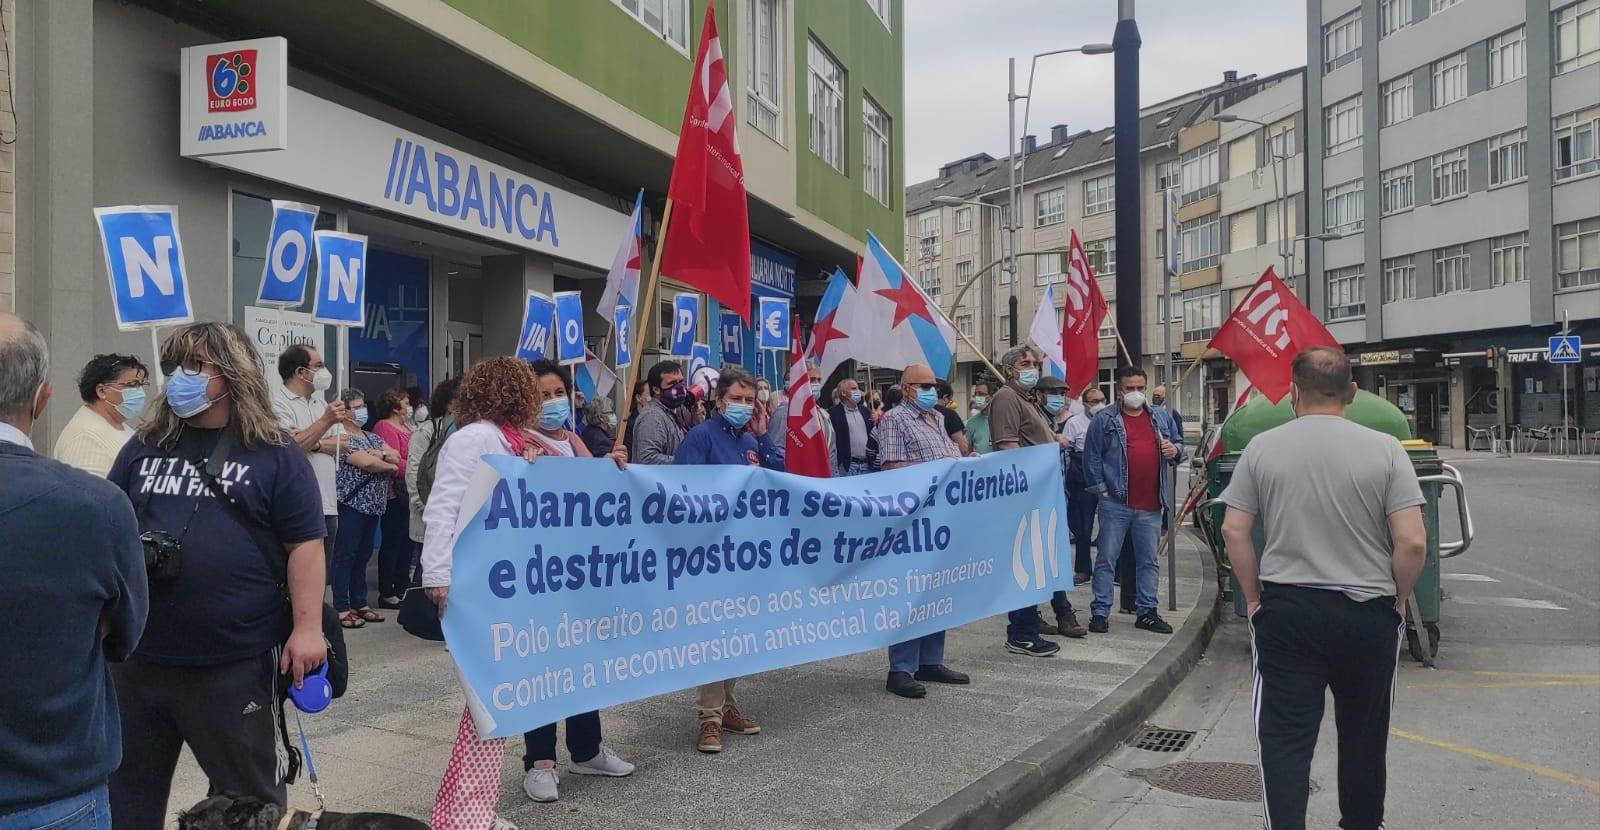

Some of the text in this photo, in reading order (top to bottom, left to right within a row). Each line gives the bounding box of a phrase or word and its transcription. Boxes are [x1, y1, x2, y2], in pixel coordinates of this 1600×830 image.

[210, 97, 254, 109] EURO 6000
[120, 235, 175, 298] N
[271, 229, 307, 283] O
[328, 254, 361, 304] N
[775, 263, 795, 293] NORTE
[565, 319, 579, 345] O
[677, 309, 693, 343] P
[723, 325, 740, 354] H
[766, 310, 782, 338] €
[1507, 352, 1539, 363] TRIPLE
[181, 459, 250, 486] HVY.
[140, 475, 236, 503] RUN FAT.
[484, 478, 632, 530] Abanca
[641, 482, 729, 525] deixa
[732, 488, 790, 520] sen
[801, 489, 921, 518] servizo
[945, 463, 1029, 506] clientela
[488, 517, 951, 599] e destrúe postos de traballo
[490, 556, 994, 662] Polo dereito ao acceso aos servizos financeiros
[492, 596, 953, 711] contra a reconversión antisocial da banca
